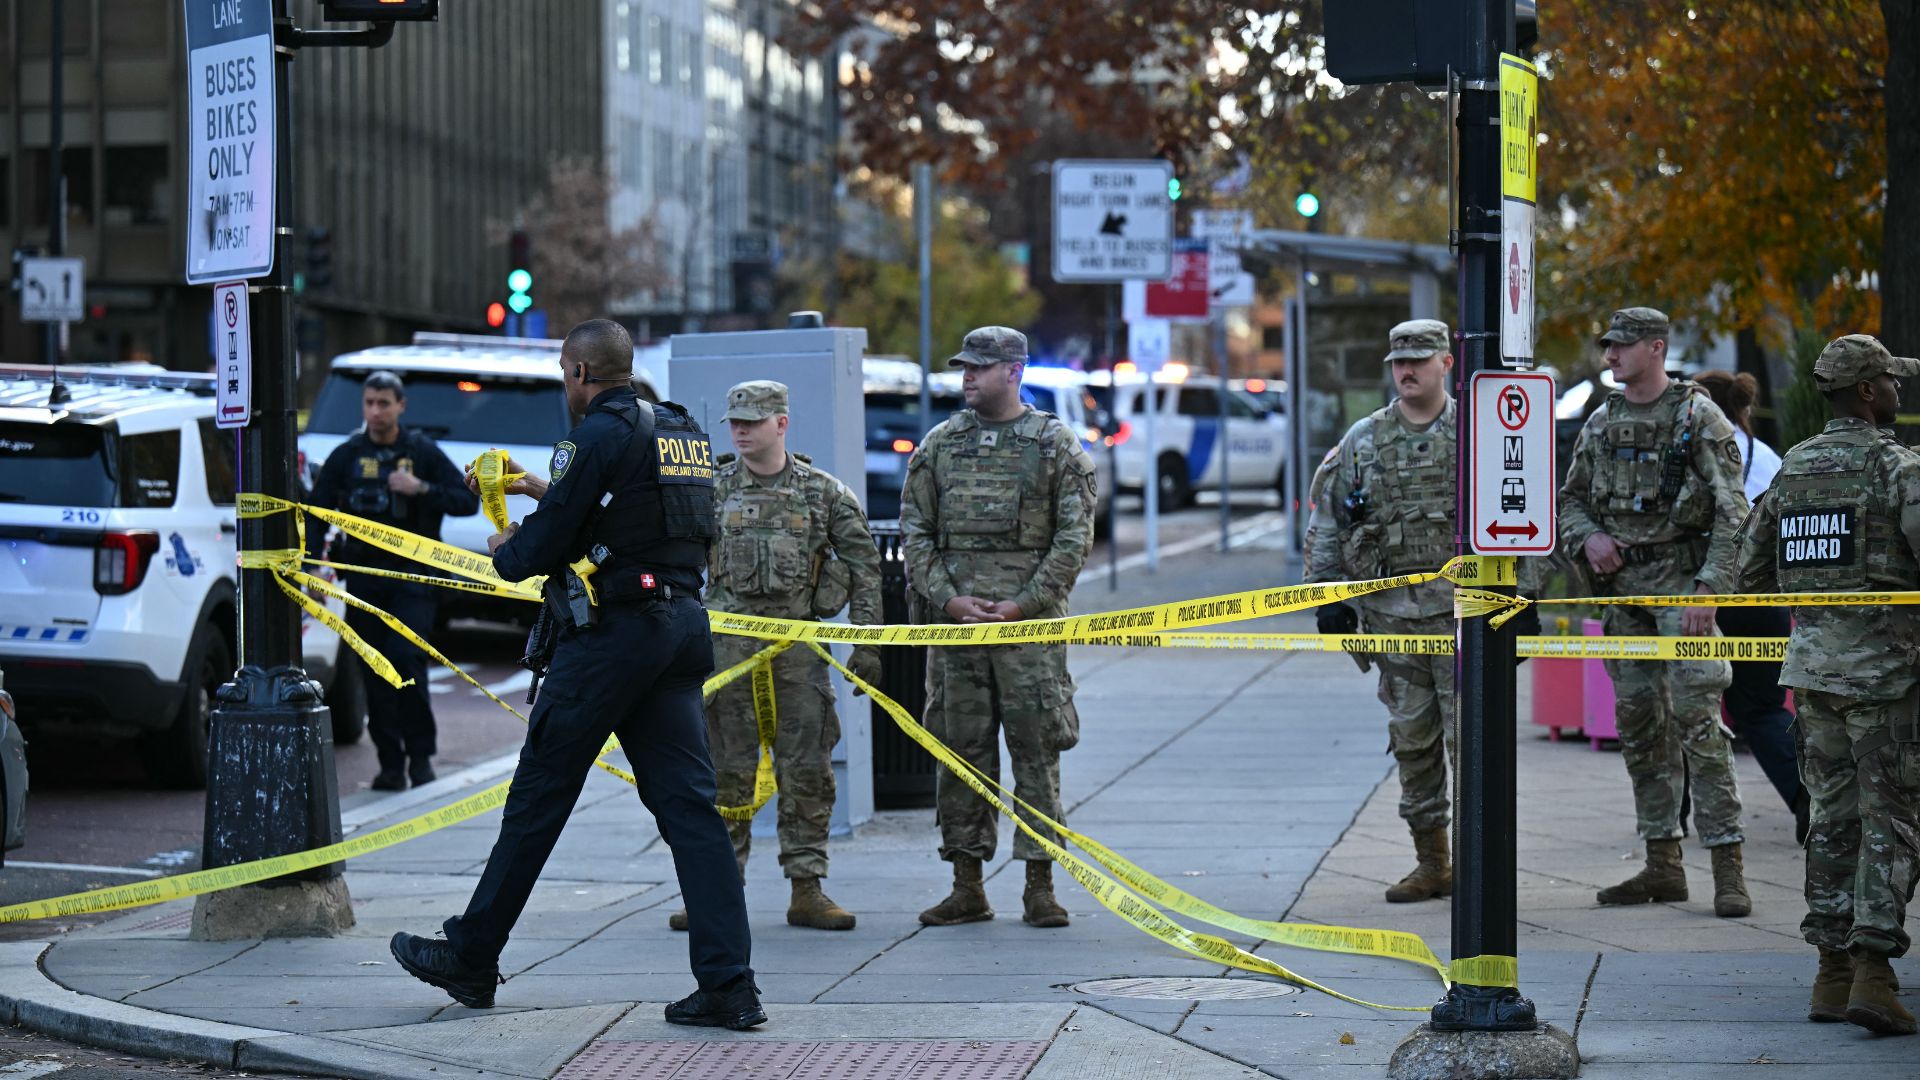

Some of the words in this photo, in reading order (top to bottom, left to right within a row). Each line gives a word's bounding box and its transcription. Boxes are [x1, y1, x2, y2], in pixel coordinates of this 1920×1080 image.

[213, 0, 242, 29] LANE
[206, 56, 256, 98] BUSES
[207, 100, 257, 141] BIKES
[209, 141, 254, 181] ONLY
[209, 191, 253, 216] 7AM-7PM
[657, 437, 711, 466] POLICE
[1506, 437, 1520, 461] M
[660, 466, 691, 476] HOMELAND
[62, 510, 100, 524] 210
[1781, 513, 1850, 539] NATIONAL
[382, 530, 404, 547] CROSS
[1786, 538, 1841, 562] GUARD
[431, 547, 453, 563] POLICE
[452, 553, 466, 568] LINE
[465, 558, 475, 570] DO
[475, 561, 488, 576] NOT
[1264, 592, 1281, 609] POLICE
[1281, 591, 1293, 606] LINE
[1178, 605, 1195, 622] POLICE
[1196, 603, 1207, 620] LINE
[1207, 602, 1215, 617] DO
[1215, 601, 1226, 617] NOT
[1226, 599, 1242, 615] CROSS
[720, 618, 743, 629] POLICE
[740, 620, 755, 631] LINE
[752, 622, 764, 632] DO
[760, 622, 775, 633] NOT
[771, 623, 792, 635] CROSS
[997, 626, 1017, 638] POLICE
[1016, 624, 1029, 637] LINE
[1028, 624, 1038, 636] DO
[1036, 622, 1049, 636] NOT
[1047, 621, 1065, 635] CROSS
[1088, 617, 1107, 632] POLICE
[1106, 615, 1120, 630] LINE
[1118, 614, 1128, 628] DO
[1126, 613, 1138, 627] NOT
[1137, 611, 1154, 626] CROSS
[814, 627, 835, 637] POLICE
[833, 628, 848, 638] LINE
[845, 628, 856, 638] DO
[853, 629, 867, 639] NOT
[864, 629, 884, 640] CROSS
[905, 629, 927, 640] POLICE
[925, 629, 939, 640] LINE
[937, 629, 947, 639] DO
[944, 628, 959, 639] NOT
[956, 628, 975, 639] CROSS
[1126, 635, 1160, 647] CRIME
[1341, 638, 1376, 653] CROSS
[1381, 639, 1399, 653] NOT
[1404, 639, 1417, 654] DO
[1675, 641, 1710, 657] CROSS
[1714, 642, 1734, 657] NOT
[1738, 642, 1751, 657] DO
[1067, 860, 1084, 880] LINE
[1080, 867, 1105, 895] POLICE
